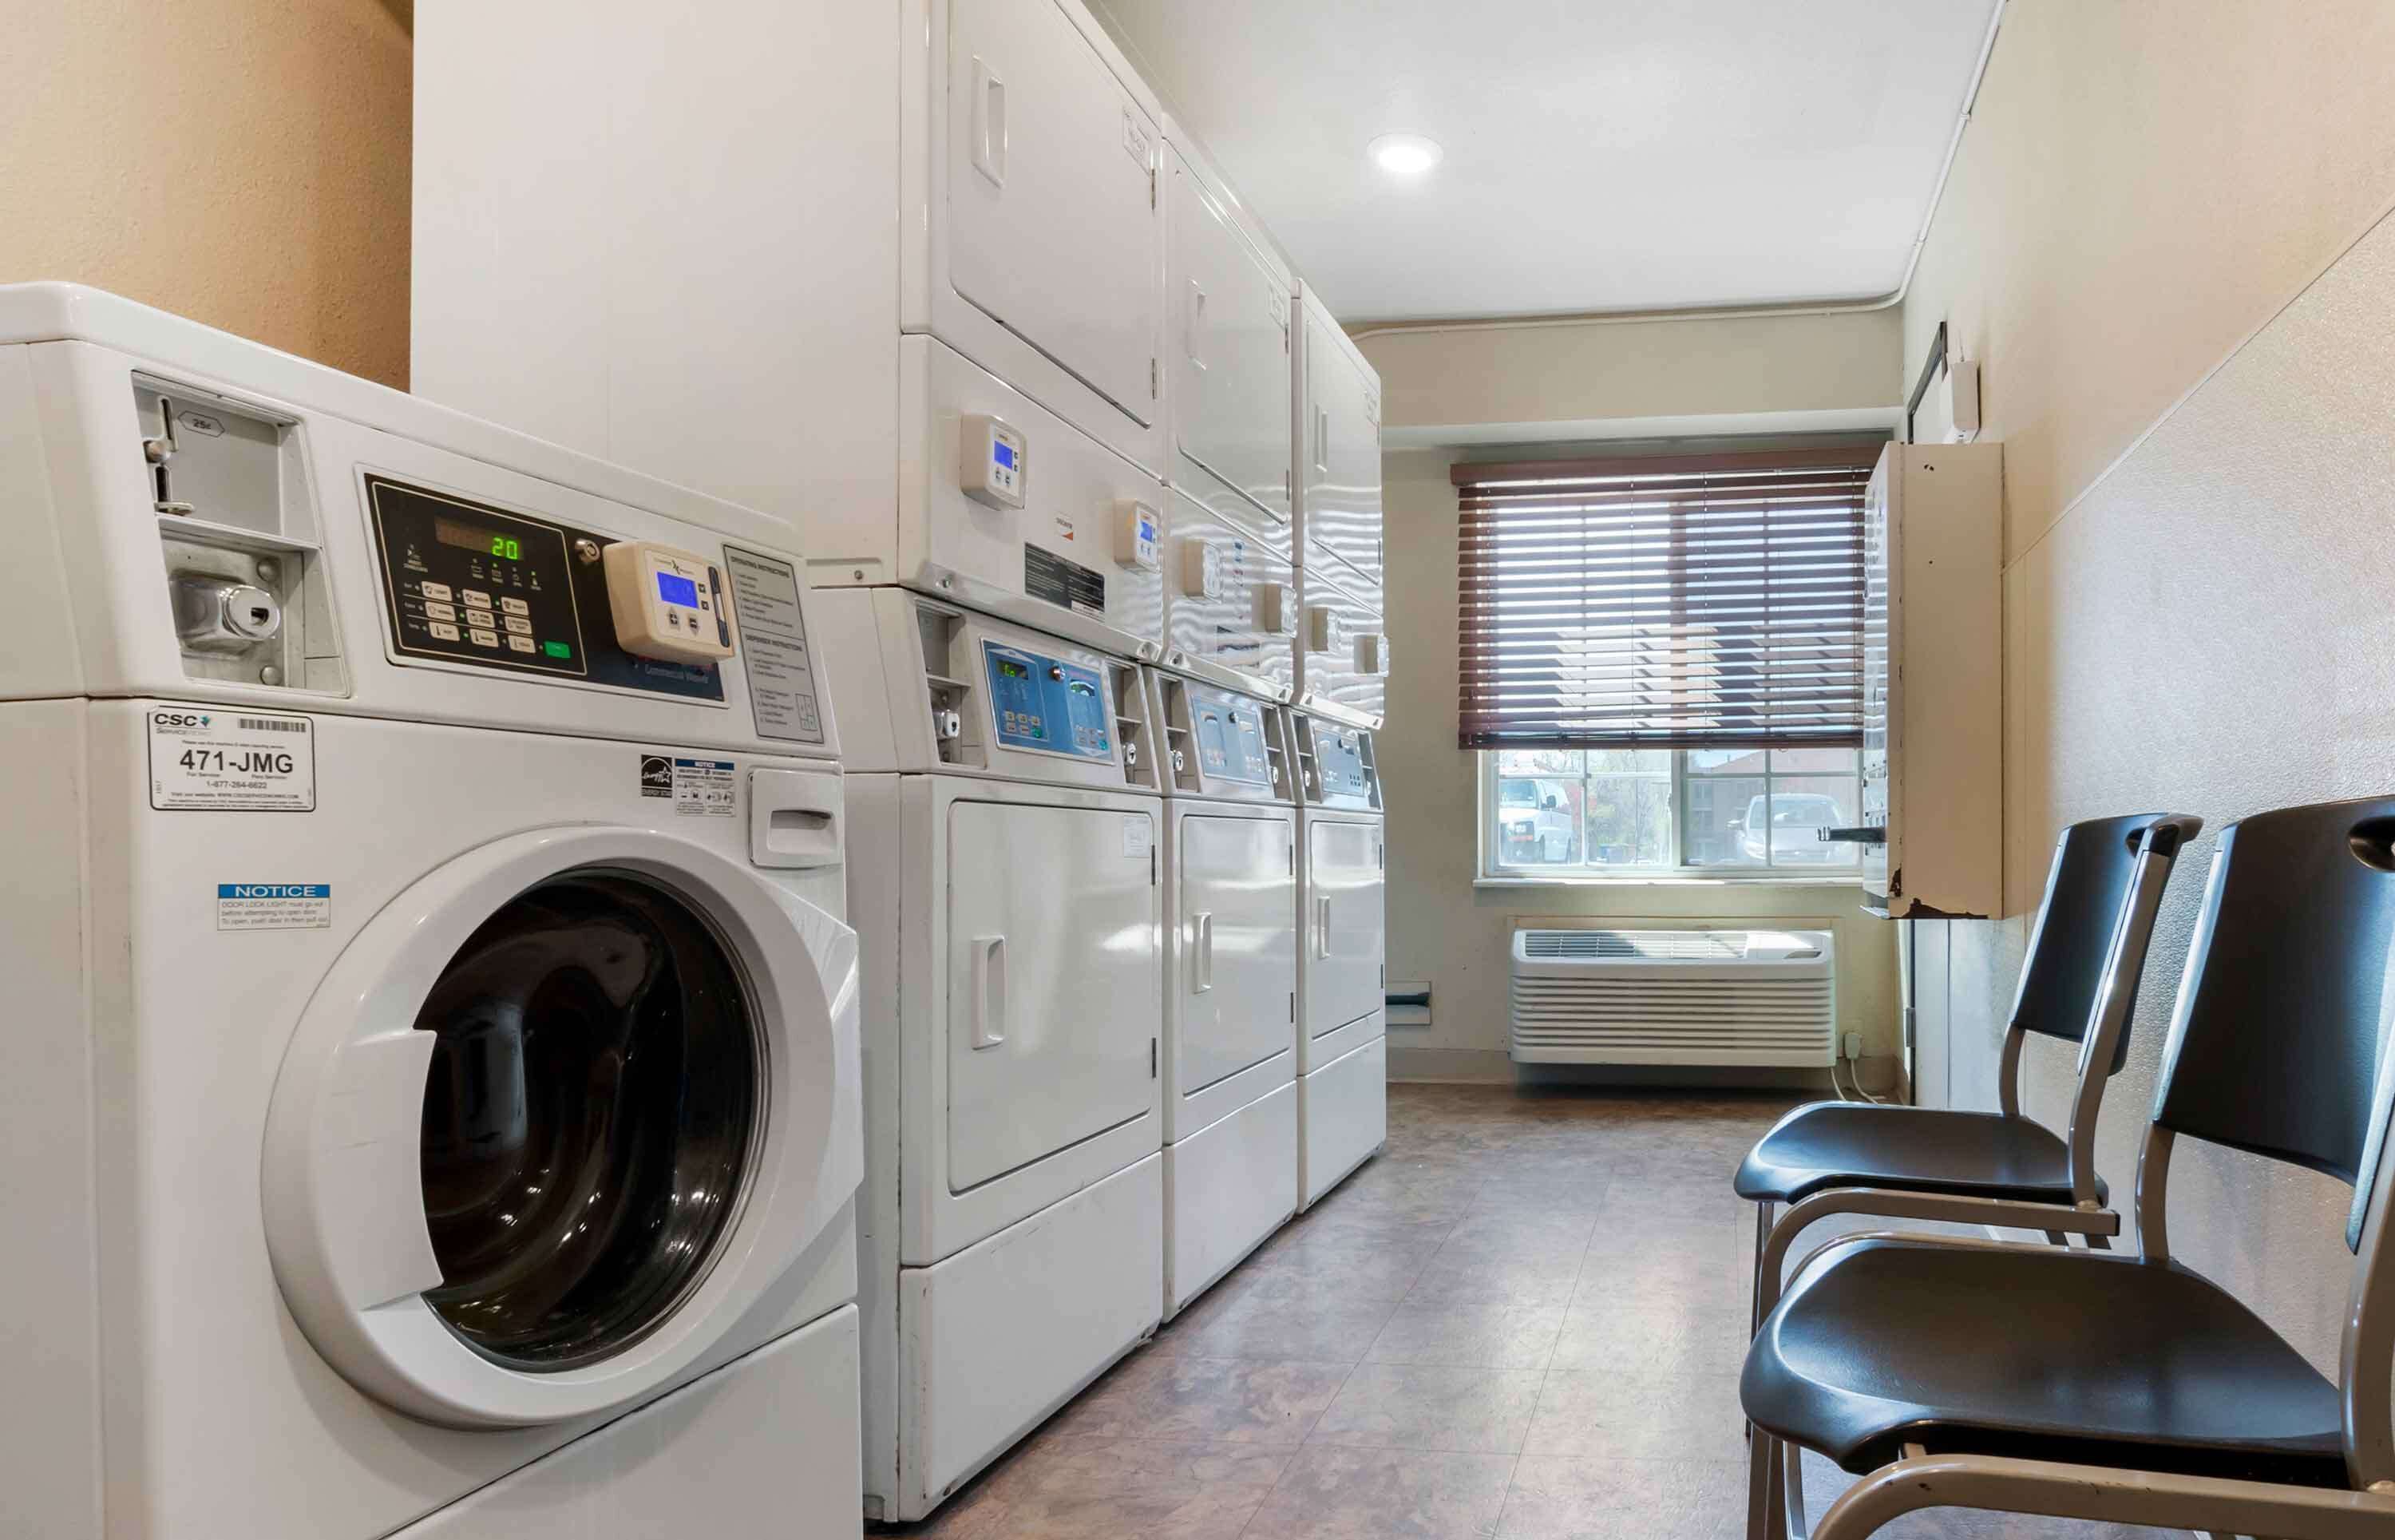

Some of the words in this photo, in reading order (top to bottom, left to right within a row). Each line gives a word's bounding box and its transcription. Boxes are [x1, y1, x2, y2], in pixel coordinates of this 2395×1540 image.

[491, 536, 518, 560] 20
[154, 714, 198, 726] CSC
[180, 749, 294, 773] 471-JMG
[236, 886, 317, 897] NOTICE
